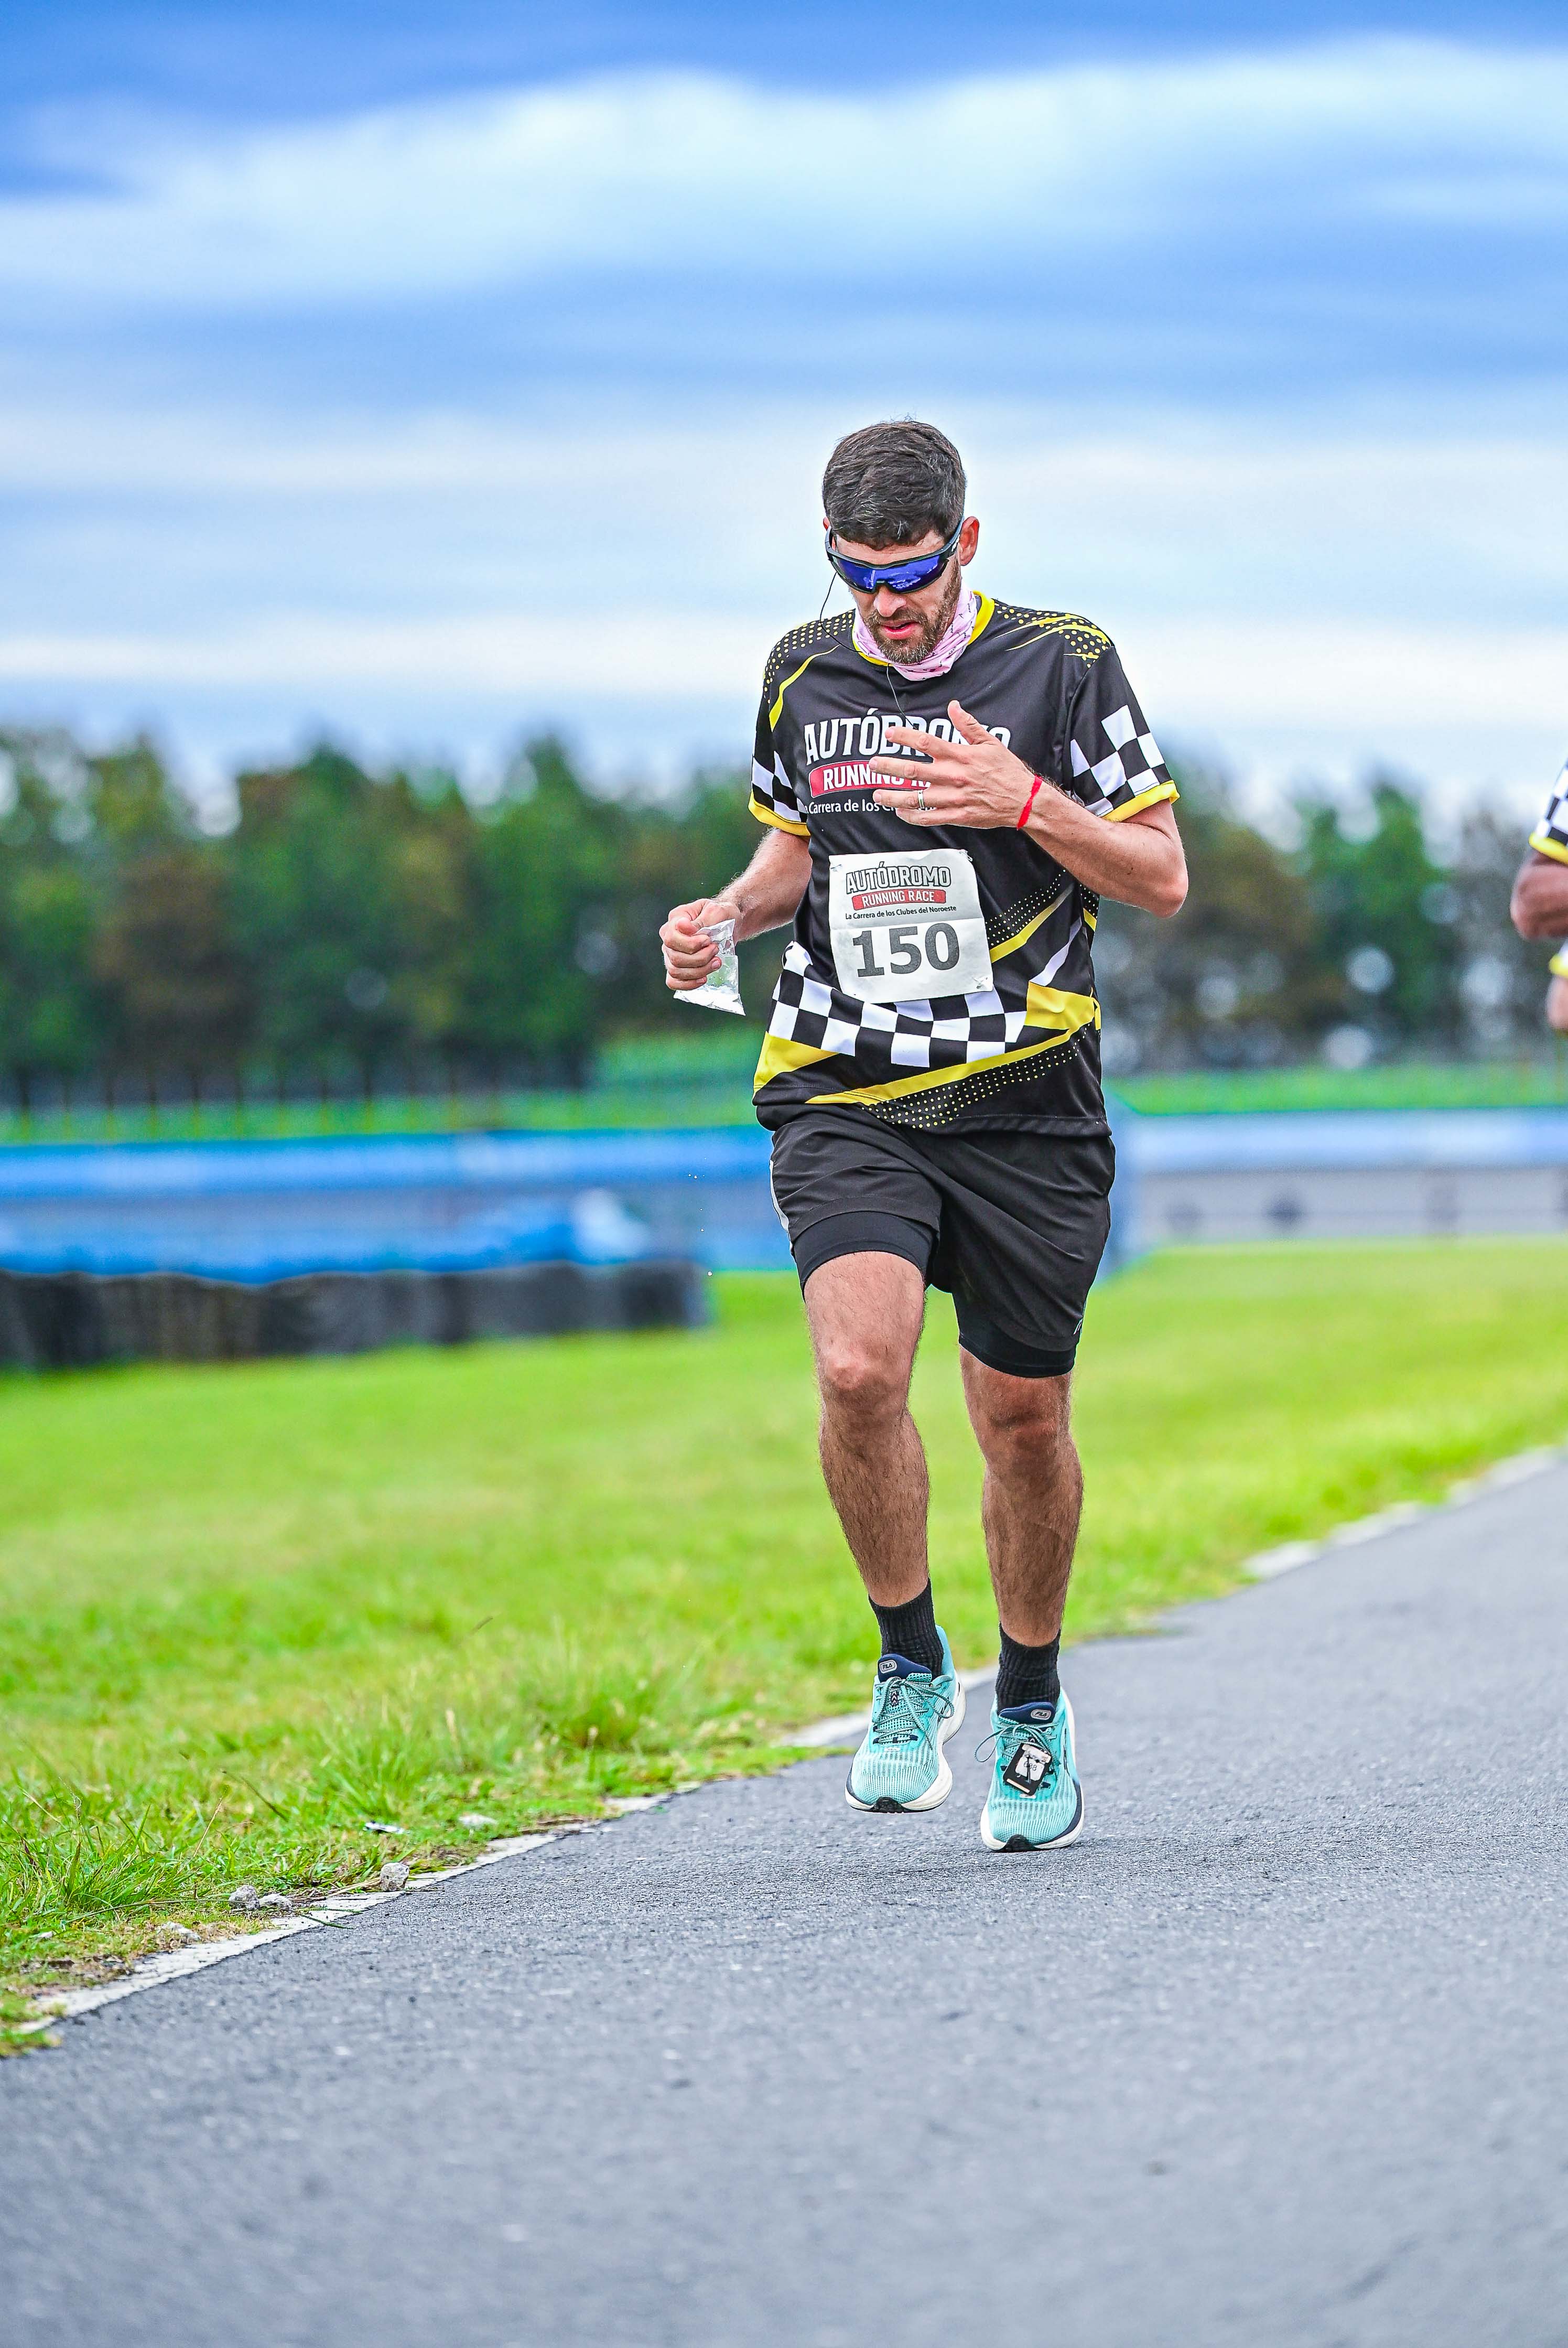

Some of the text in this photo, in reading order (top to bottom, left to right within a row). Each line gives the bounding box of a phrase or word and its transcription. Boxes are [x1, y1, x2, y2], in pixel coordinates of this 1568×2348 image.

[809, 801, 841, 814] Carrera
[844, 799, 859, 812] de
[862, 799, 880, 812] los
[846, 861, 952, 895] AUTÓDROMO
[861, 890, 935, 908] RUNNING RACE
[852, 923, 960, 977] 150
